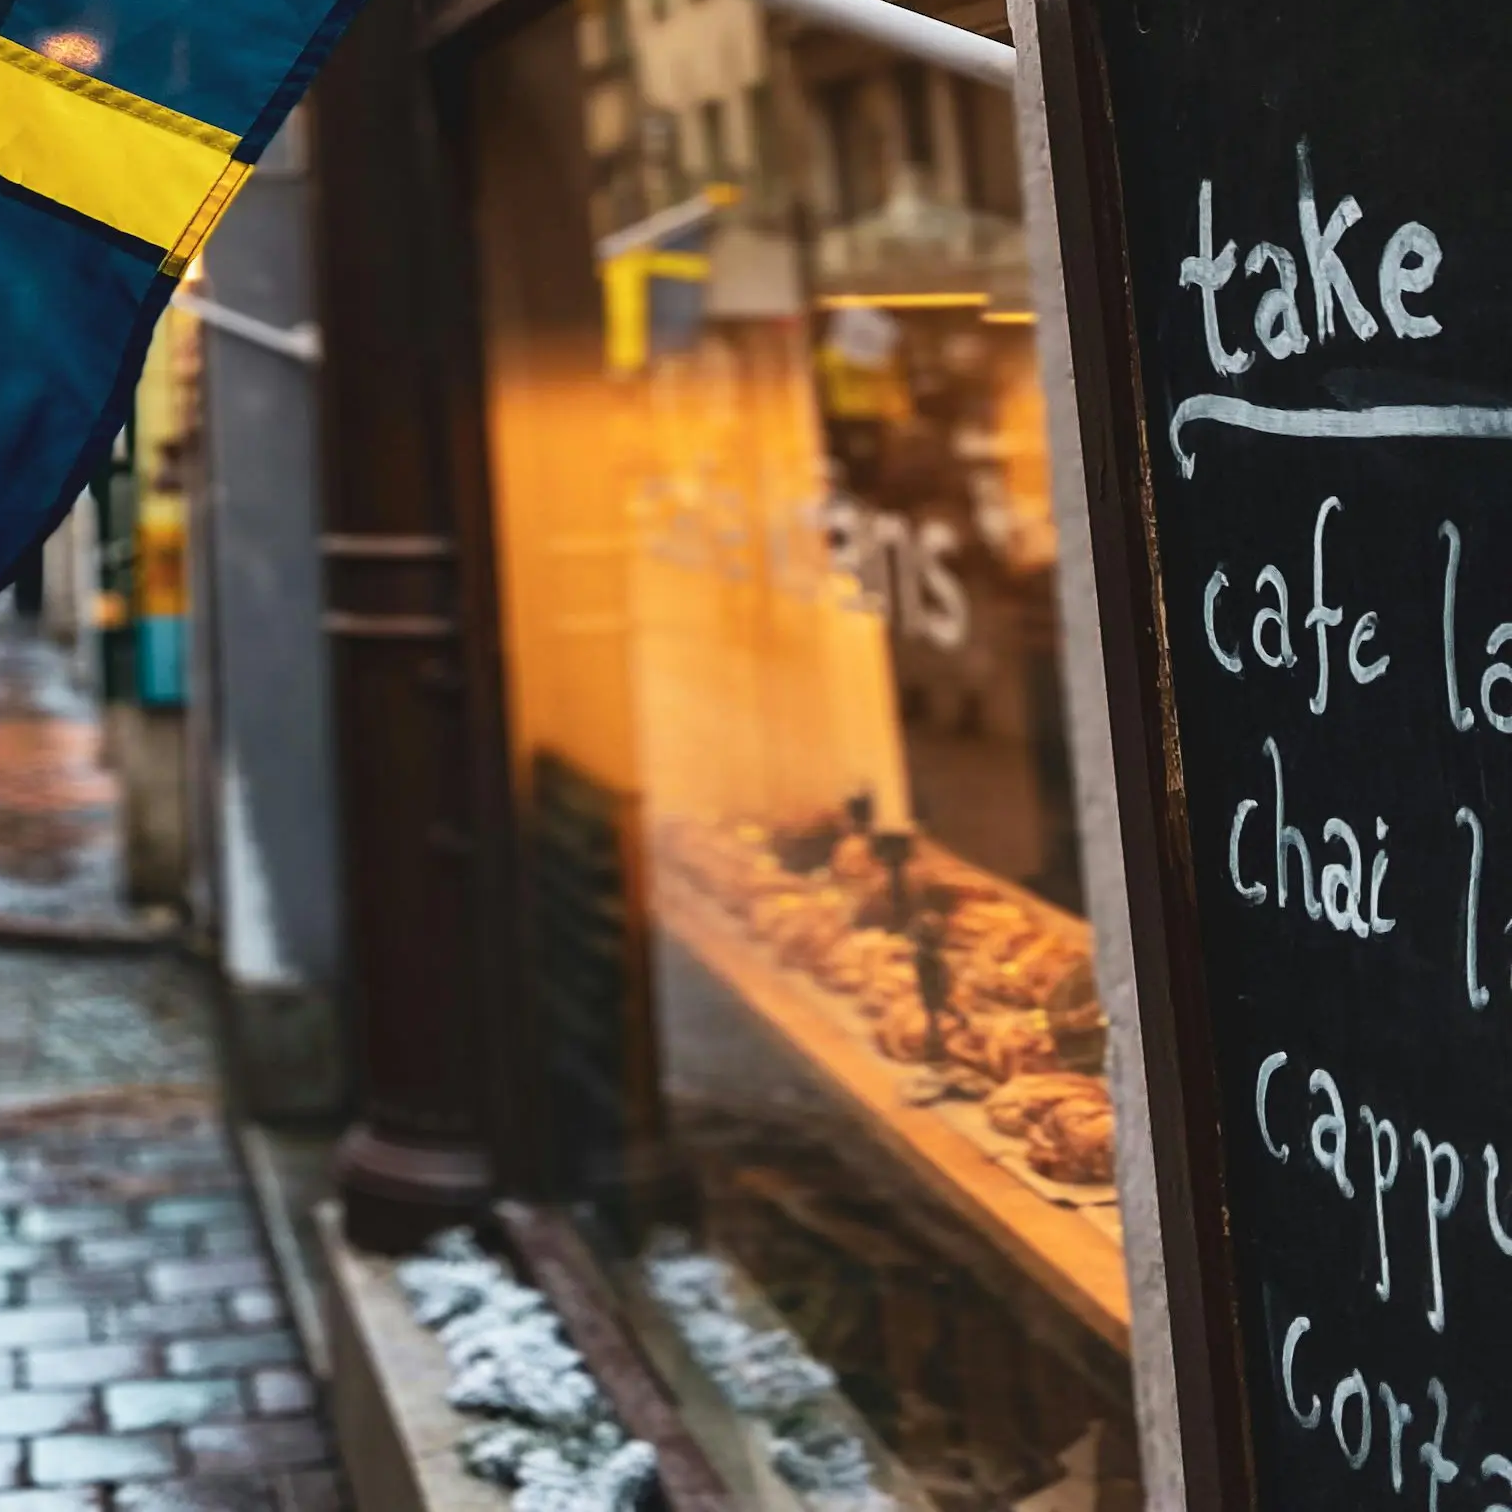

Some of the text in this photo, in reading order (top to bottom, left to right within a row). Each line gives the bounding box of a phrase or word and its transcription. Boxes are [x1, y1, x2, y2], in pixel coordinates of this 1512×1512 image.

[1179, 134, 1443, 377] take
[1204, 496, 1390, 715] cafe
[1229, 736, 1396, 938] chai
